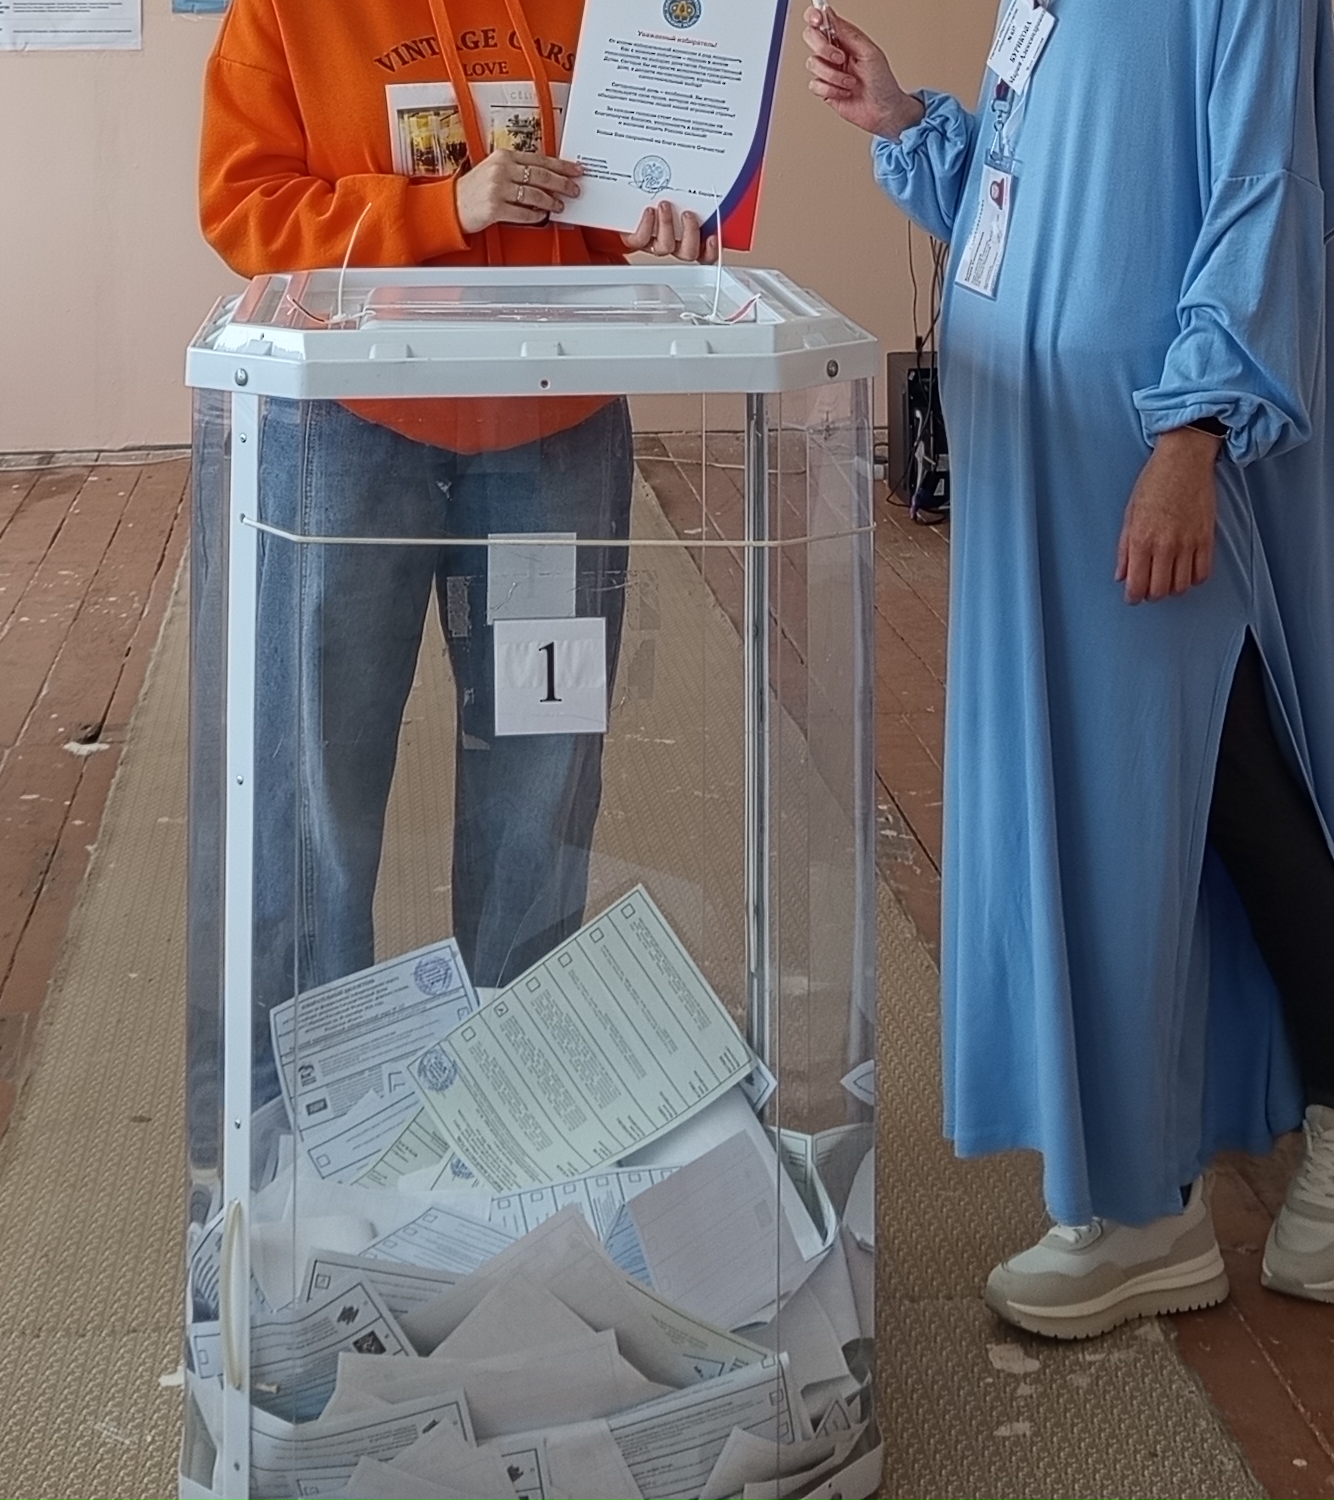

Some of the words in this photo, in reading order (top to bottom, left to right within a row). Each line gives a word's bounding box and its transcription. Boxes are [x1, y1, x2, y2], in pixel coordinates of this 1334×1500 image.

[374, 28, 498, 74] VINTGE
[464, 61, 509, 77] LOVE
[539, 641, 562, 703] 1
